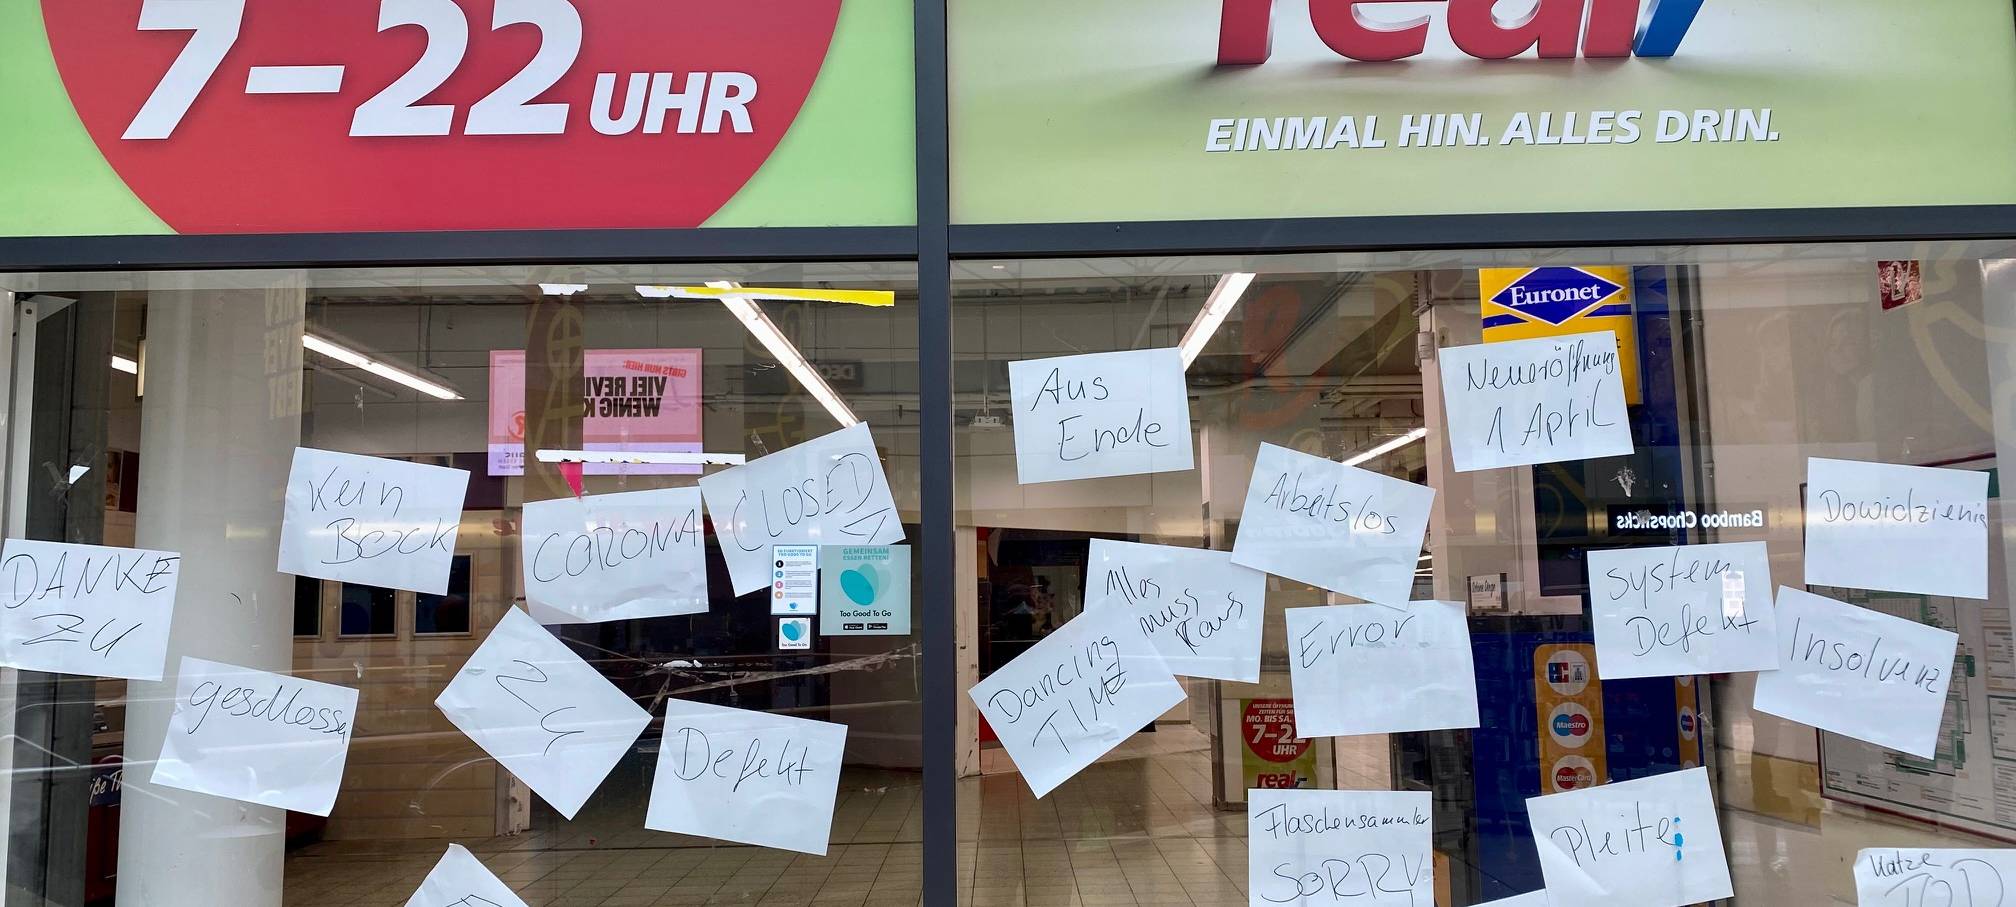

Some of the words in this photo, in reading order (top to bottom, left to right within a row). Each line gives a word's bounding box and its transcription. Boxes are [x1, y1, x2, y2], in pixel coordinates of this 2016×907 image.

[589, 71, 758, 136] UHR
[1204, 115, 1388, 153] EINMAL
[1399, 112, 1490, 148] HIN.
[1500, 109, 1642, 146] ALLES
[1655, 108, 1780, 144] DRIN.
[1508, 283, 1601, 307] Euronet
[1030, 367, 1110, 412] Aus
[1057, 407, 1169, 462] Ende
[308, 466, 403, 513] Kein
[1264, 472, 1399, 536] Arbeitslos
[321, 517, 460, 565] Bock
[533, 509, 698, 583] CORONA
[1, 551, 180, 609] DANKE
[881, 609, 892, 617] Go
[1625, 603, 1759, 657] Defekt
[1300, 613, 1416, 670] Error
[1790, 617, 1943, 695] Insolvenz
[988, 633, 1121, 725] Dancing
[1246, 715, 1262, 723] MO.
[1264, 715, 1278, 723] BIS
[1278, 715, 1292, 723] SA.
[1556, 721, 1588, 730] Maestro
[672, 727, 814, 793] Defekt
[1272, 745, 1298, 756] UHR
[1557, 774, 1592, 783] MasterCard
[1869, 850, 1943, 878] Katze
